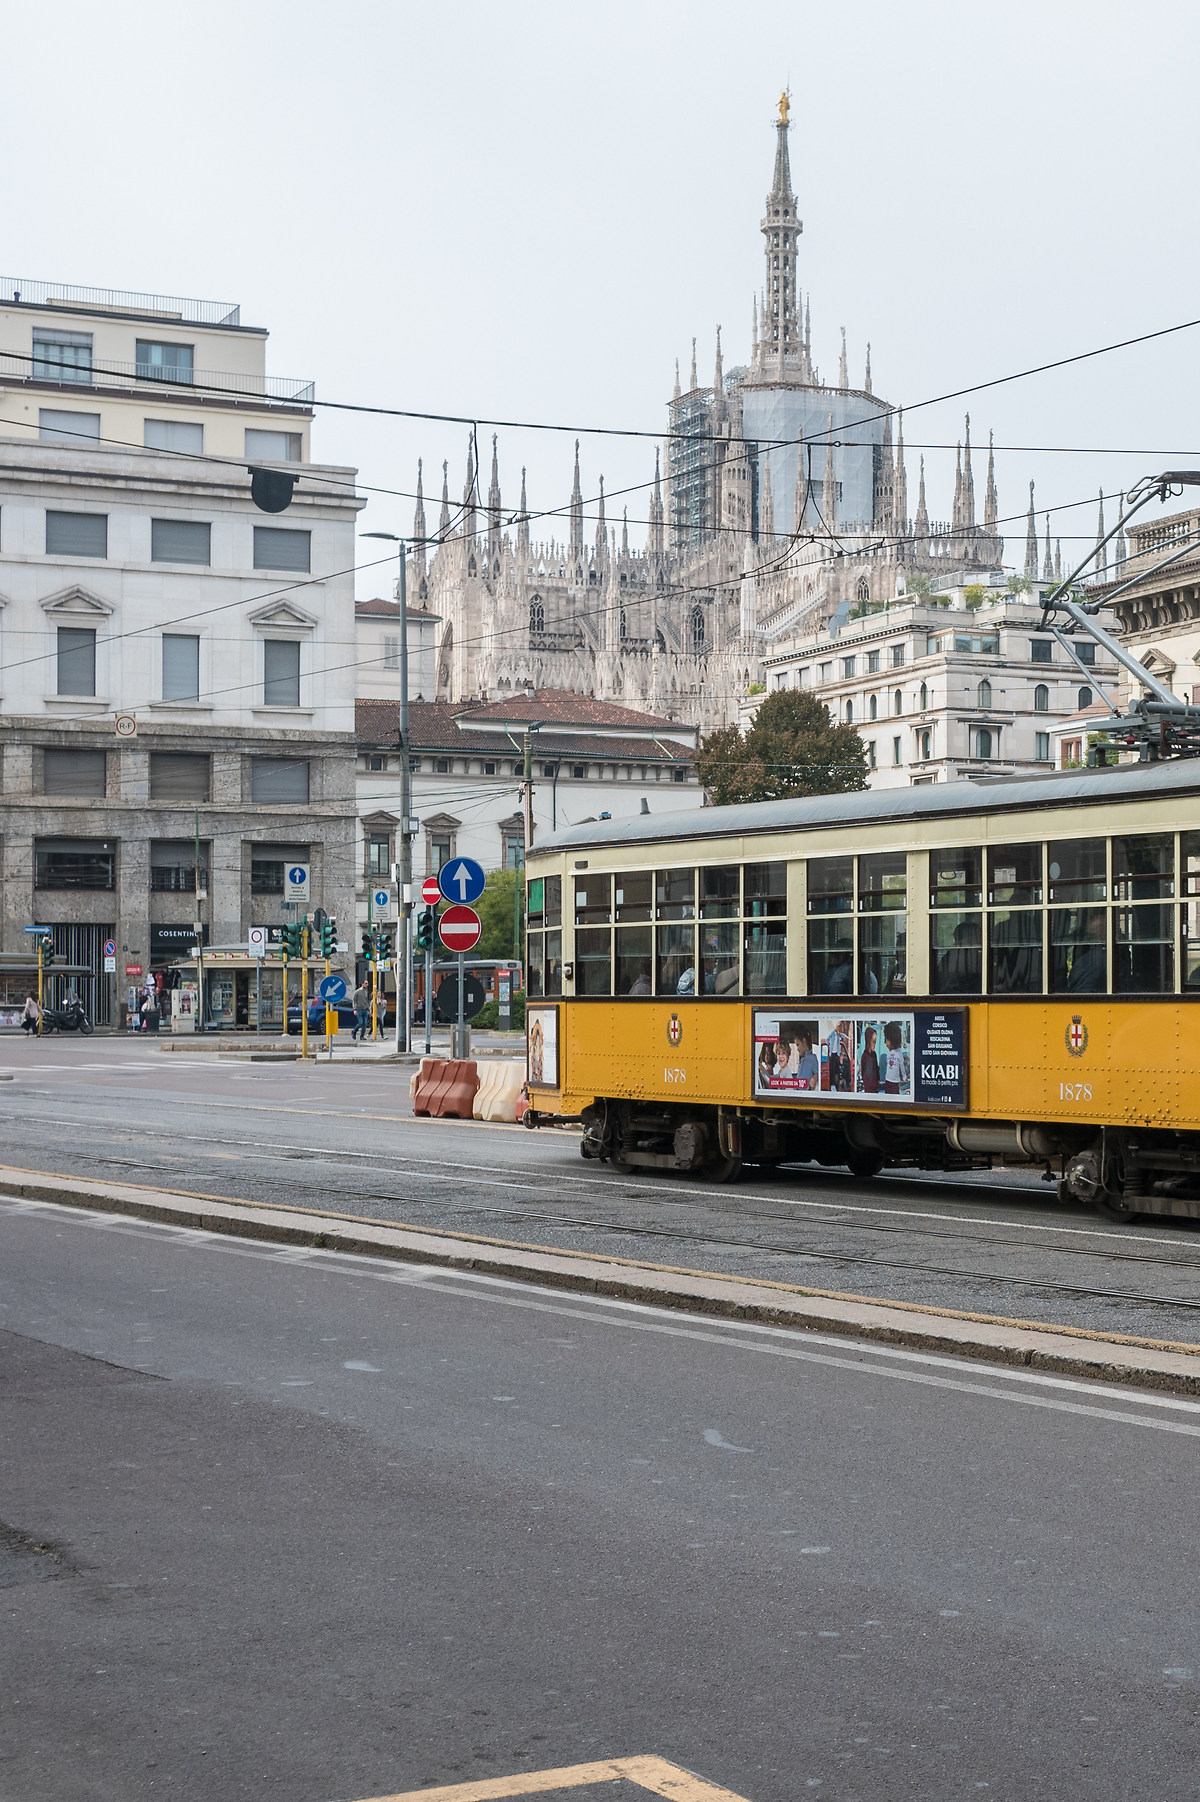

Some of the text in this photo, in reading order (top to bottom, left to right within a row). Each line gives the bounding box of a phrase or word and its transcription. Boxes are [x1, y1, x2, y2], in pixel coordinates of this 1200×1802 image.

[664, 1067, 687, 1084] 1878
[921, 1064, 959, 1080] KIABI
[1060, 1082, 1093, 1102] 1878
